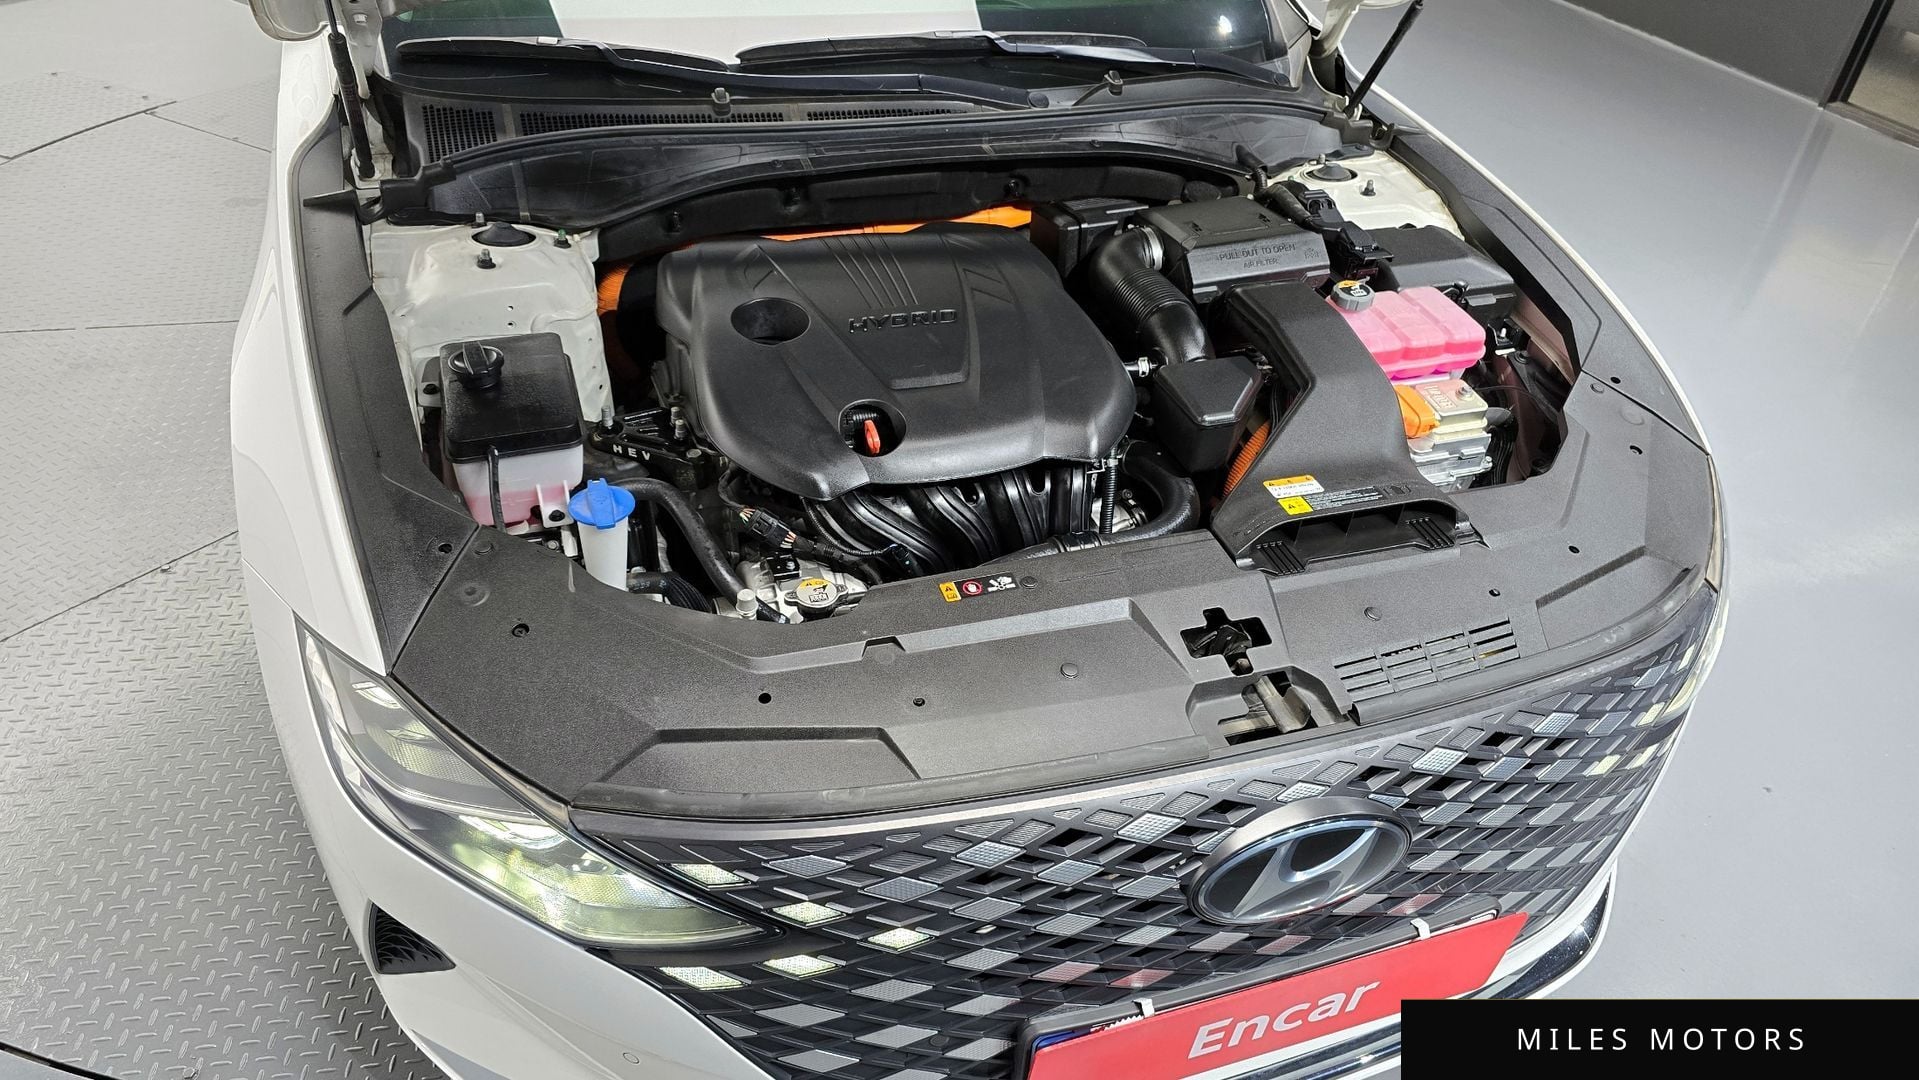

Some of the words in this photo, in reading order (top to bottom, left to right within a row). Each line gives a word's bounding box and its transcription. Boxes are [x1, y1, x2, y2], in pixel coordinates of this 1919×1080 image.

[1219, 249, 1241, 260] PULL
[1242, 246, 1258, 257] OUT
[1262, 246, 1271, 254] TO
[1273, 243, 1296, 252] OPEN
[1243, 261, 1255, 269] AIR
[848, 309, 957, 333] HYBRID
[612, 444, 651, 461] HEV
[1188, 981, 1380, 1059] Encar
